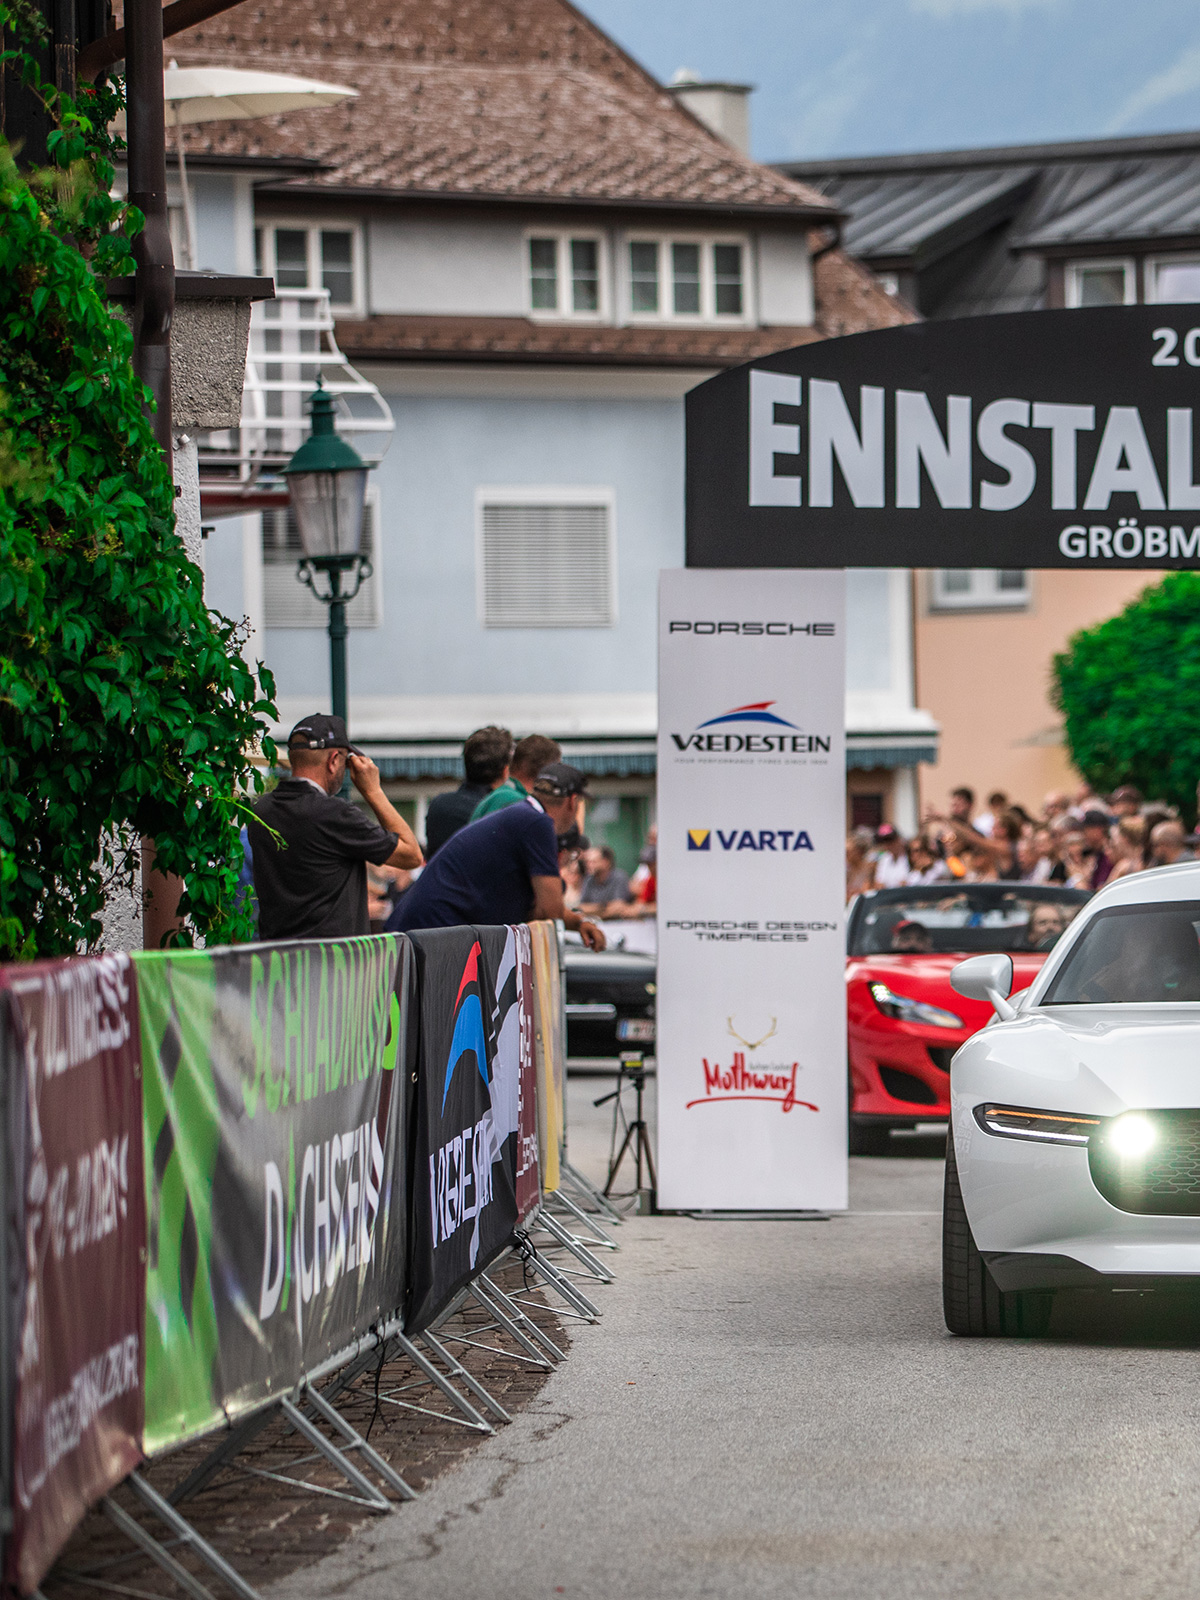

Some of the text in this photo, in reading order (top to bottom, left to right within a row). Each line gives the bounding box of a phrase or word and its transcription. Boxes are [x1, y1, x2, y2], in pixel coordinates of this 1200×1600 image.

[669, 620, 836, 636] PORSCHE
[670, 733, 831, 753] VREDESTEIN
[716, 830, 815, 851] VARTA
[666, 921, 838, 931] PORSCHE DESIGN
[695, 932, 809, 942] TIMEPIECES
